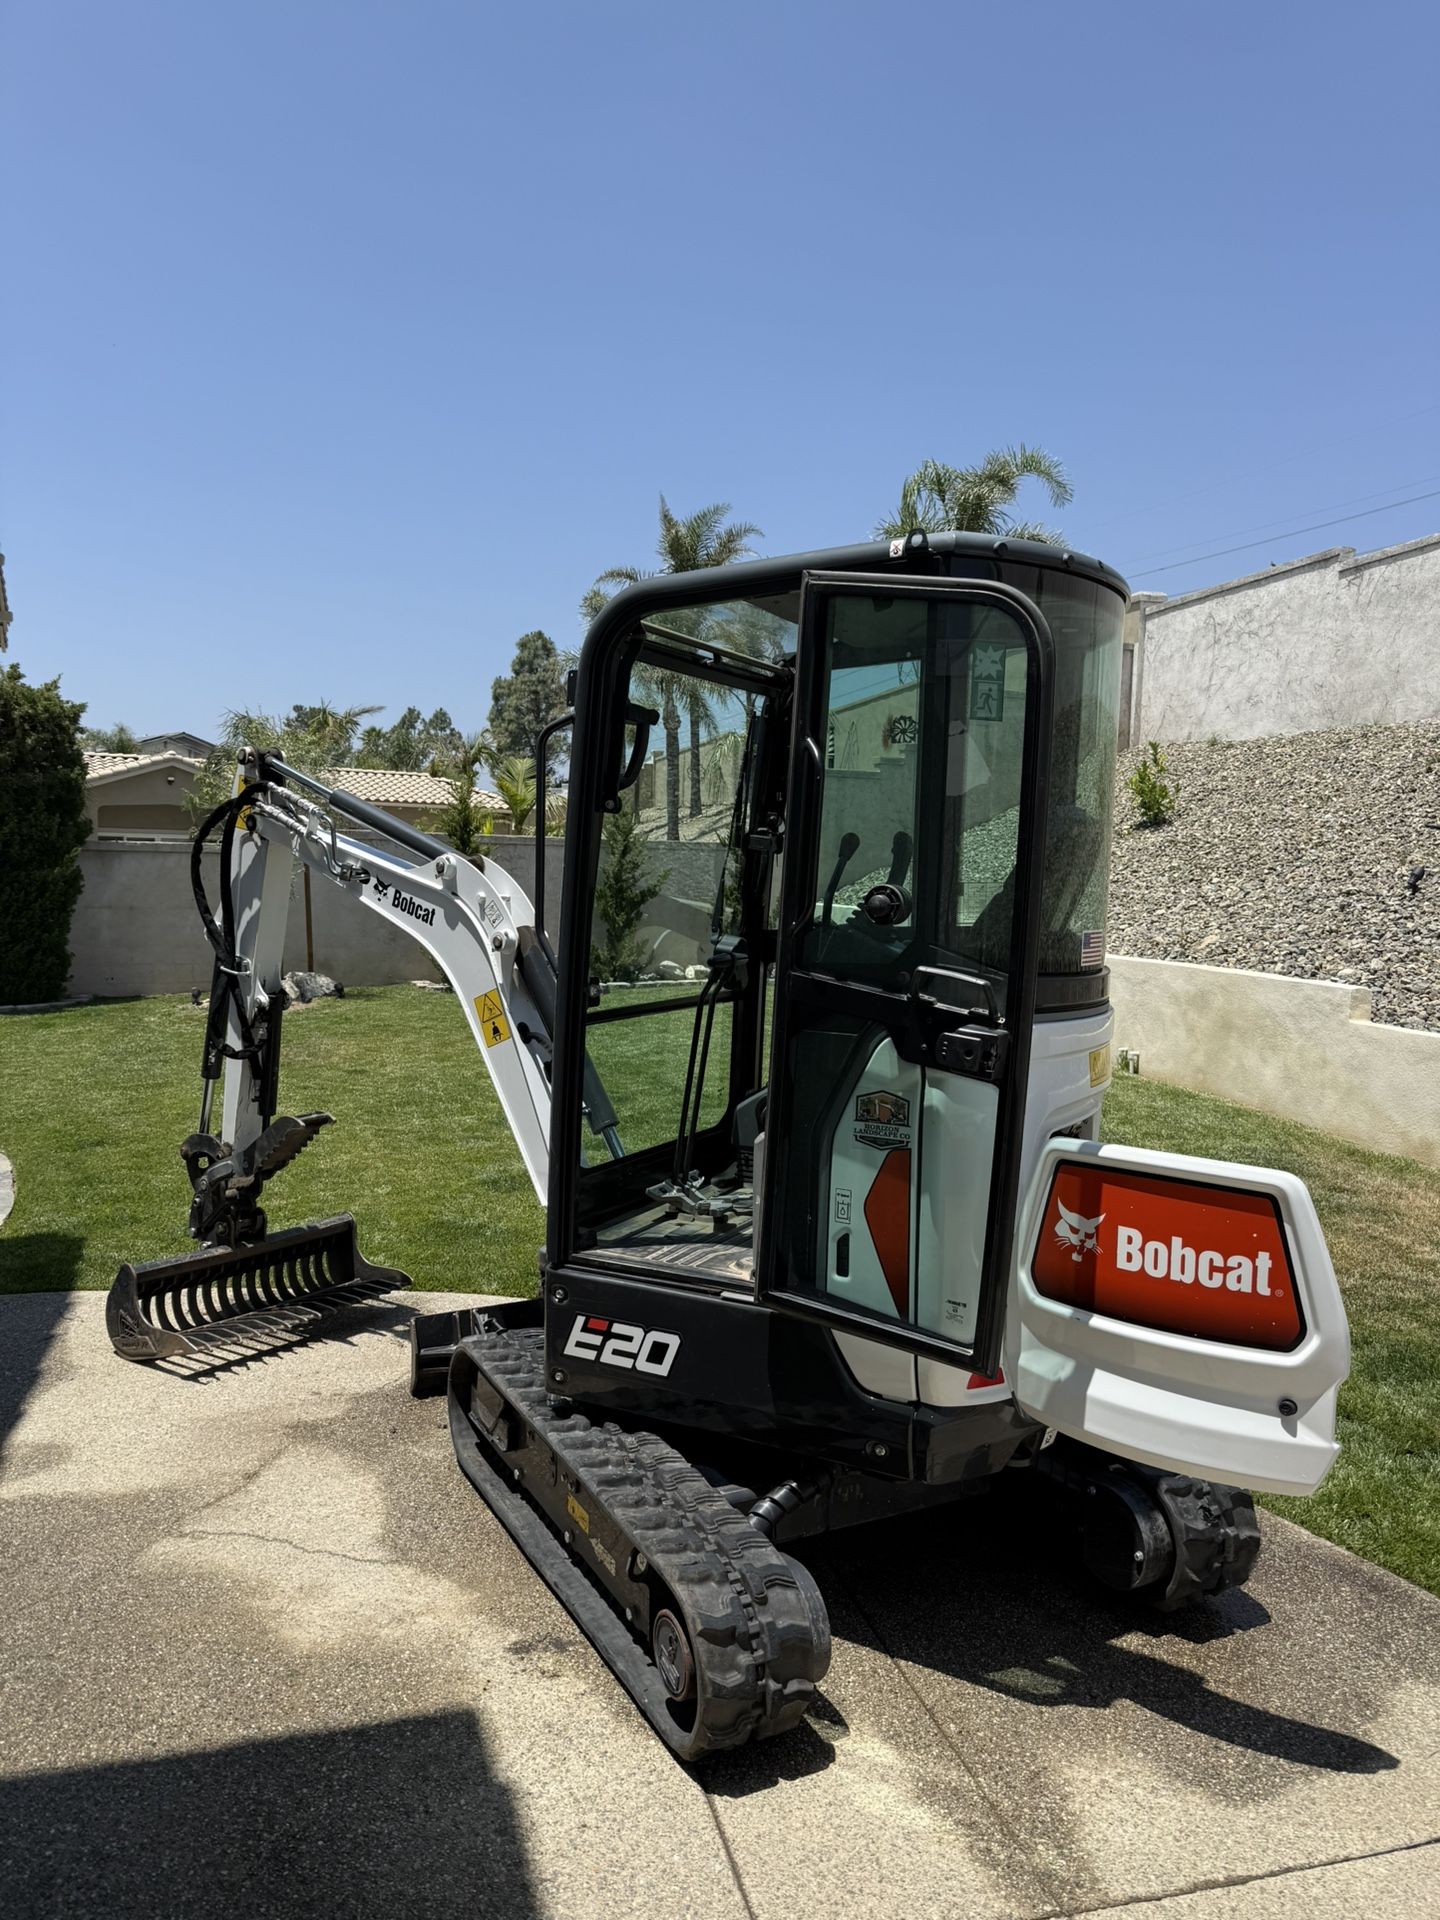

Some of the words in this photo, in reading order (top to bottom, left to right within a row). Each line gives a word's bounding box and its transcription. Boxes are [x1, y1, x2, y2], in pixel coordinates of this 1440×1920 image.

[392, 889, 436, 926] Bobcat
[854, 1127, 898, 1138] LANDSCAPE
[899, 1132, 911, 1140] CO
[864, 1123, 900, 1133] HORIZON
[1116, 1225, 1272, 1297] Bobcat
[563, 1315, 681, 1377] E20
